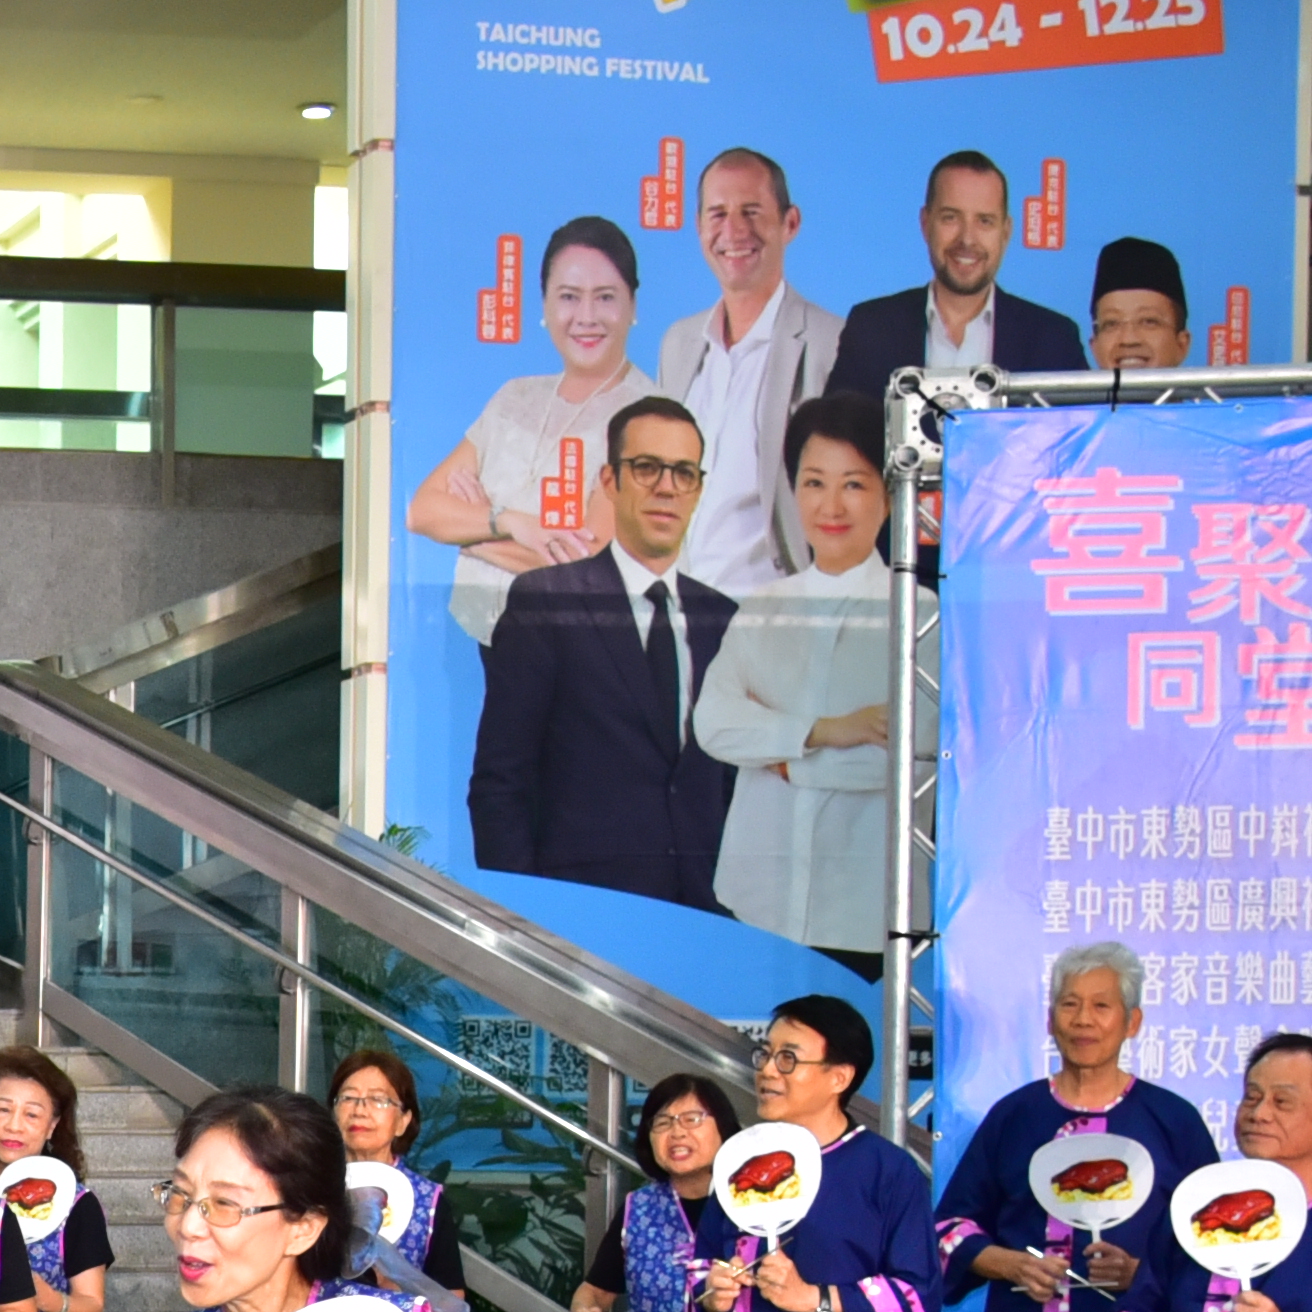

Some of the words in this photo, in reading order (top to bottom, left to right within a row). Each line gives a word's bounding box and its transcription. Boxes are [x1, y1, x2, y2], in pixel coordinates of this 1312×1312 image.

[477, 22, 601, 48] TAICHUNG
[881, 2, 1023, 61] 10.24
[477, 51, 600, 77] SHOPPING
[605, 58, 710, 83] FESTIVAL
[1031, 467, 1312, 624] 喜聚
[1128, 622, 1312, 750] 同堂
